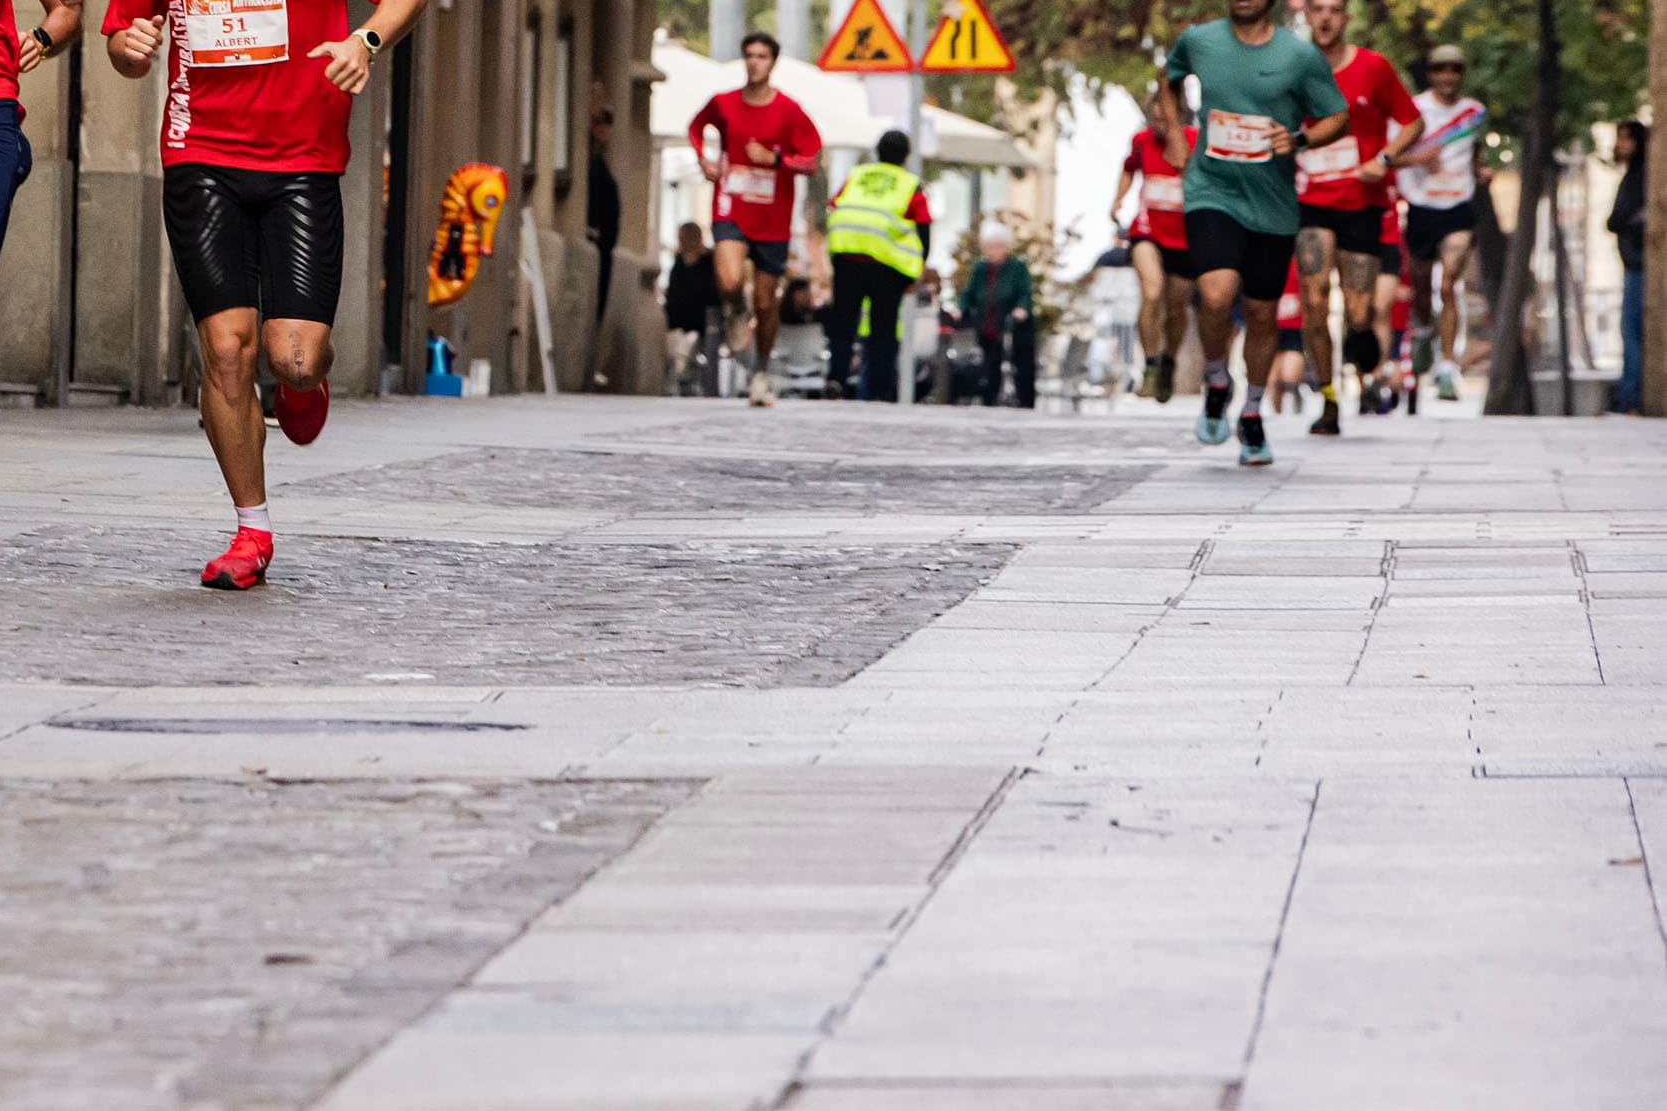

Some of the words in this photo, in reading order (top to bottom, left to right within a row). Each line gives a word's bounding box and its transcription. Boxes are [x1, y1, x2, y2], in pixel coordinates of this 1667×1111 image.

[222, 17, 248, 34] 51
[215, 37, 258, 48] ALBERT
[168, 92, 191, 140] CURSA
